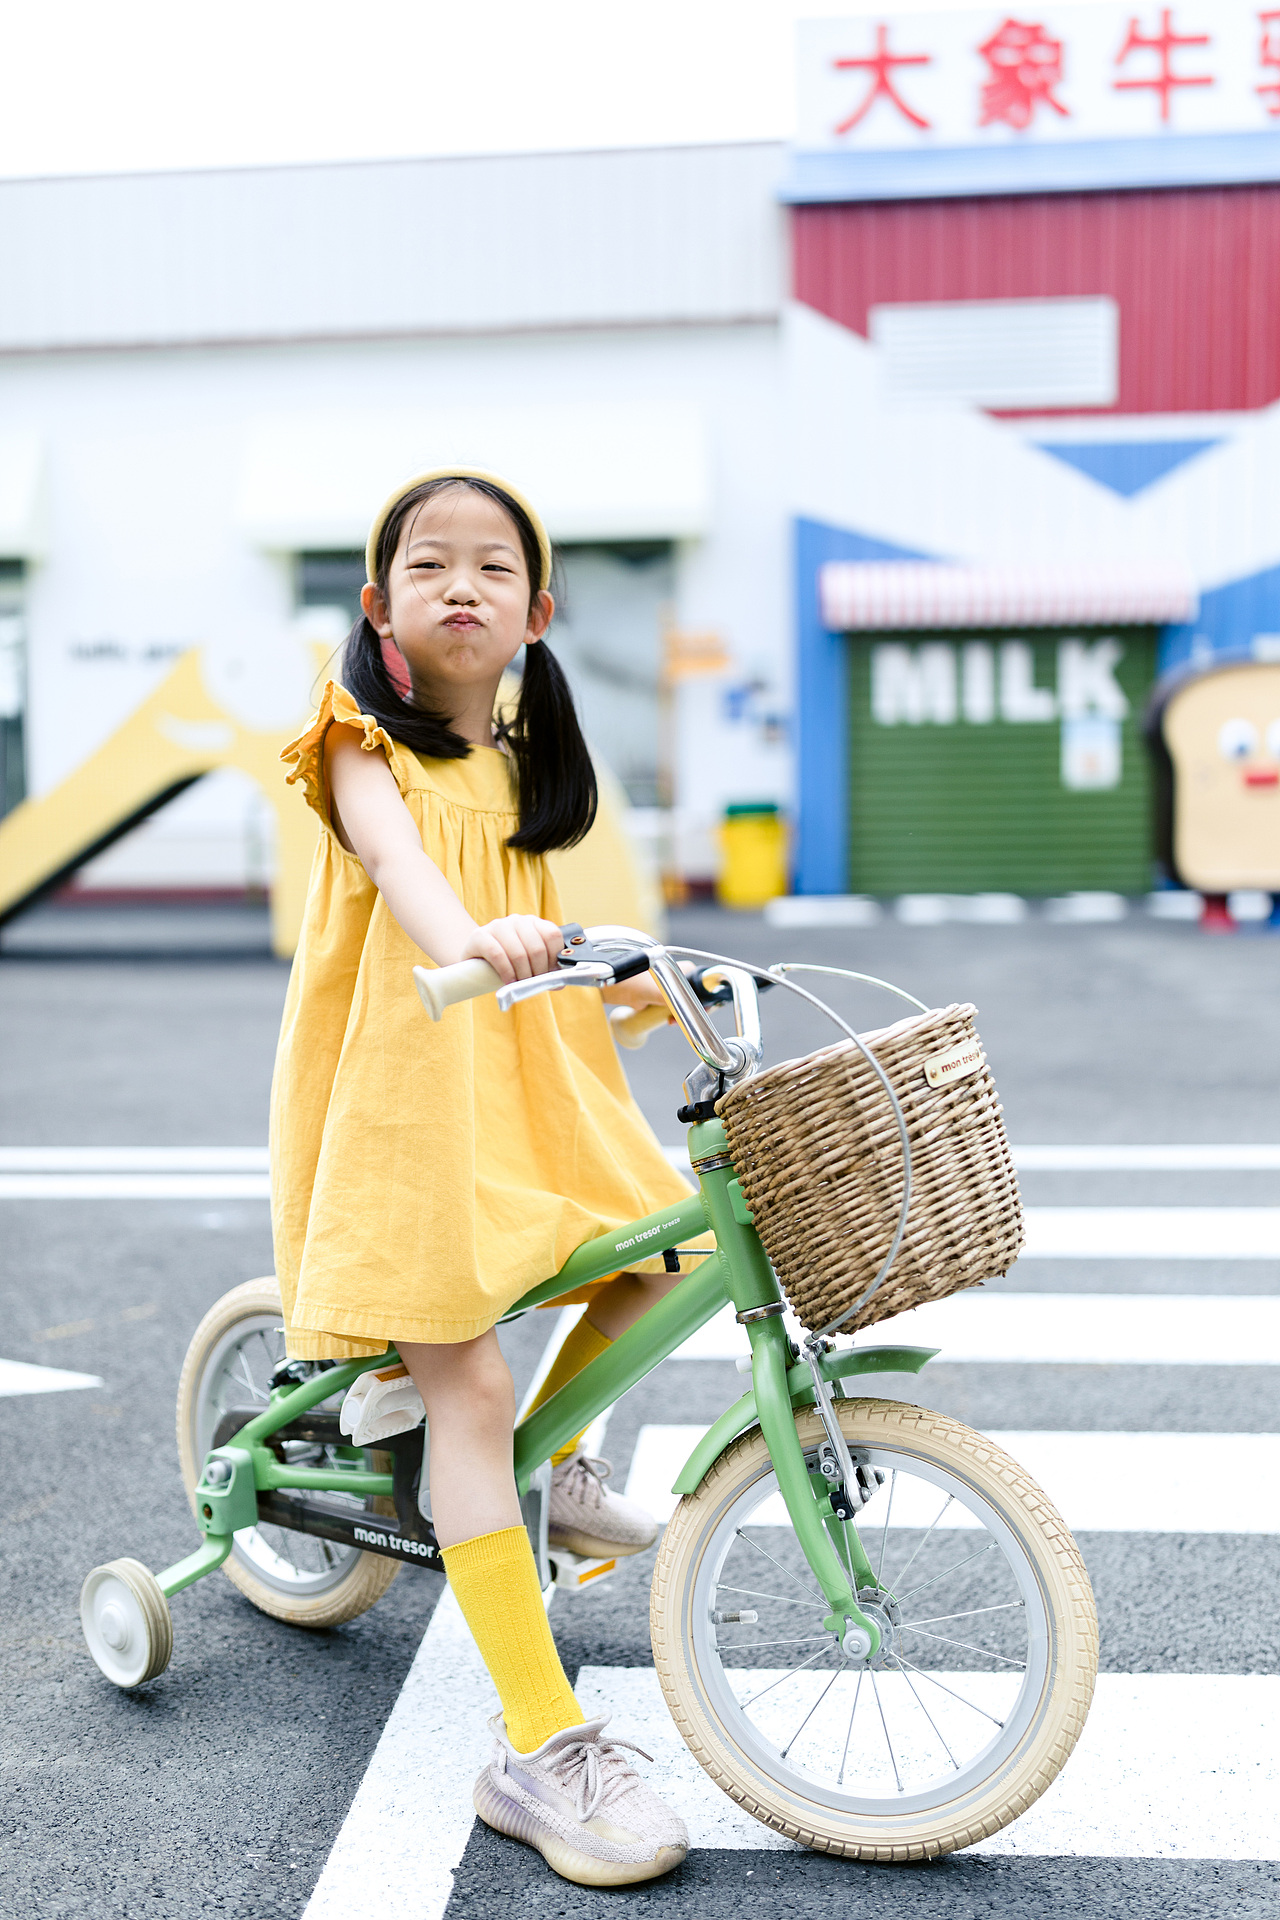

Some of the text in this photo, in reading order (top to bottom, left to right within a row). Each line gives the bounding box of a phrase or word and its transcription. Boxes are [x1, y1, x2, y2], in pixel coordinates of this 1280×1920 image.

[832, 8, 1280, 135] 大象牛
[871, 639, 1129, 725] MILK
[941, 1060, 961, 1072] mon
[615, 1217, 681, 1252] mon tresor breeze
[353, 1527, 435, 1558] mon tresor
